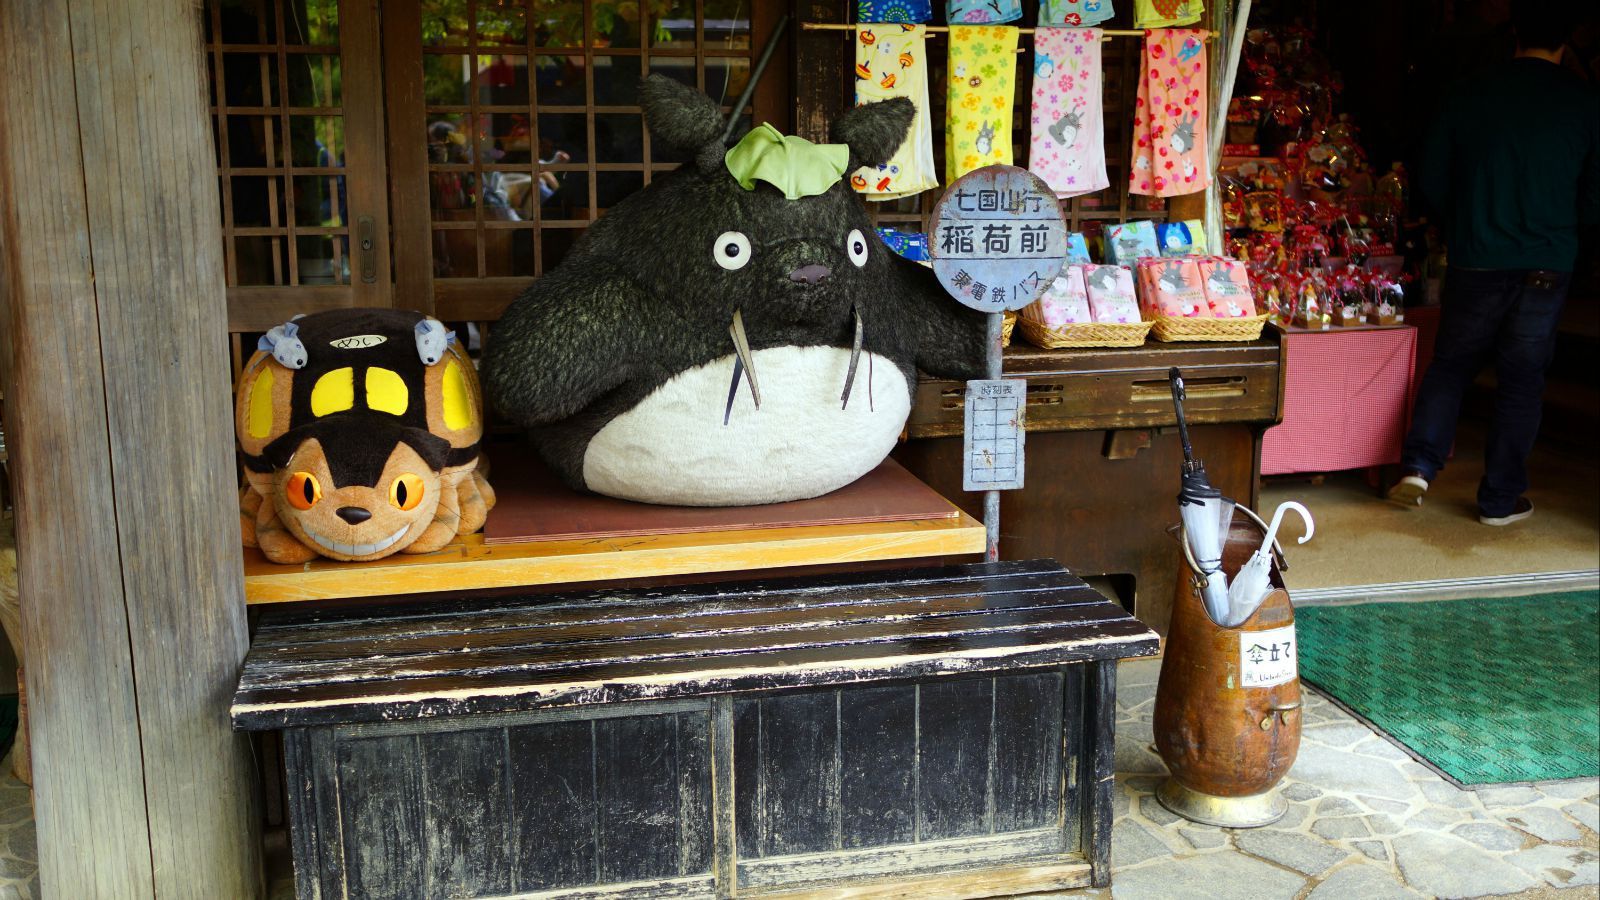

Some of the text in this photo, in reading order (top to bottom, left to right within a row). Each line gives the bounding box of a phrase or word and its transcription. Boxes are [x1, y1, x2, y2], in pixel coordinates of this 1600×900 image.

[955, 189, 1042, 212] 七国山行
[941, 224, 1049, 253] 稲荷前
[337, 336, 382, 347] めい
[981, 385, 1013, 395] 時刻表
[1246, 641, 1291, 664] 傘立て
